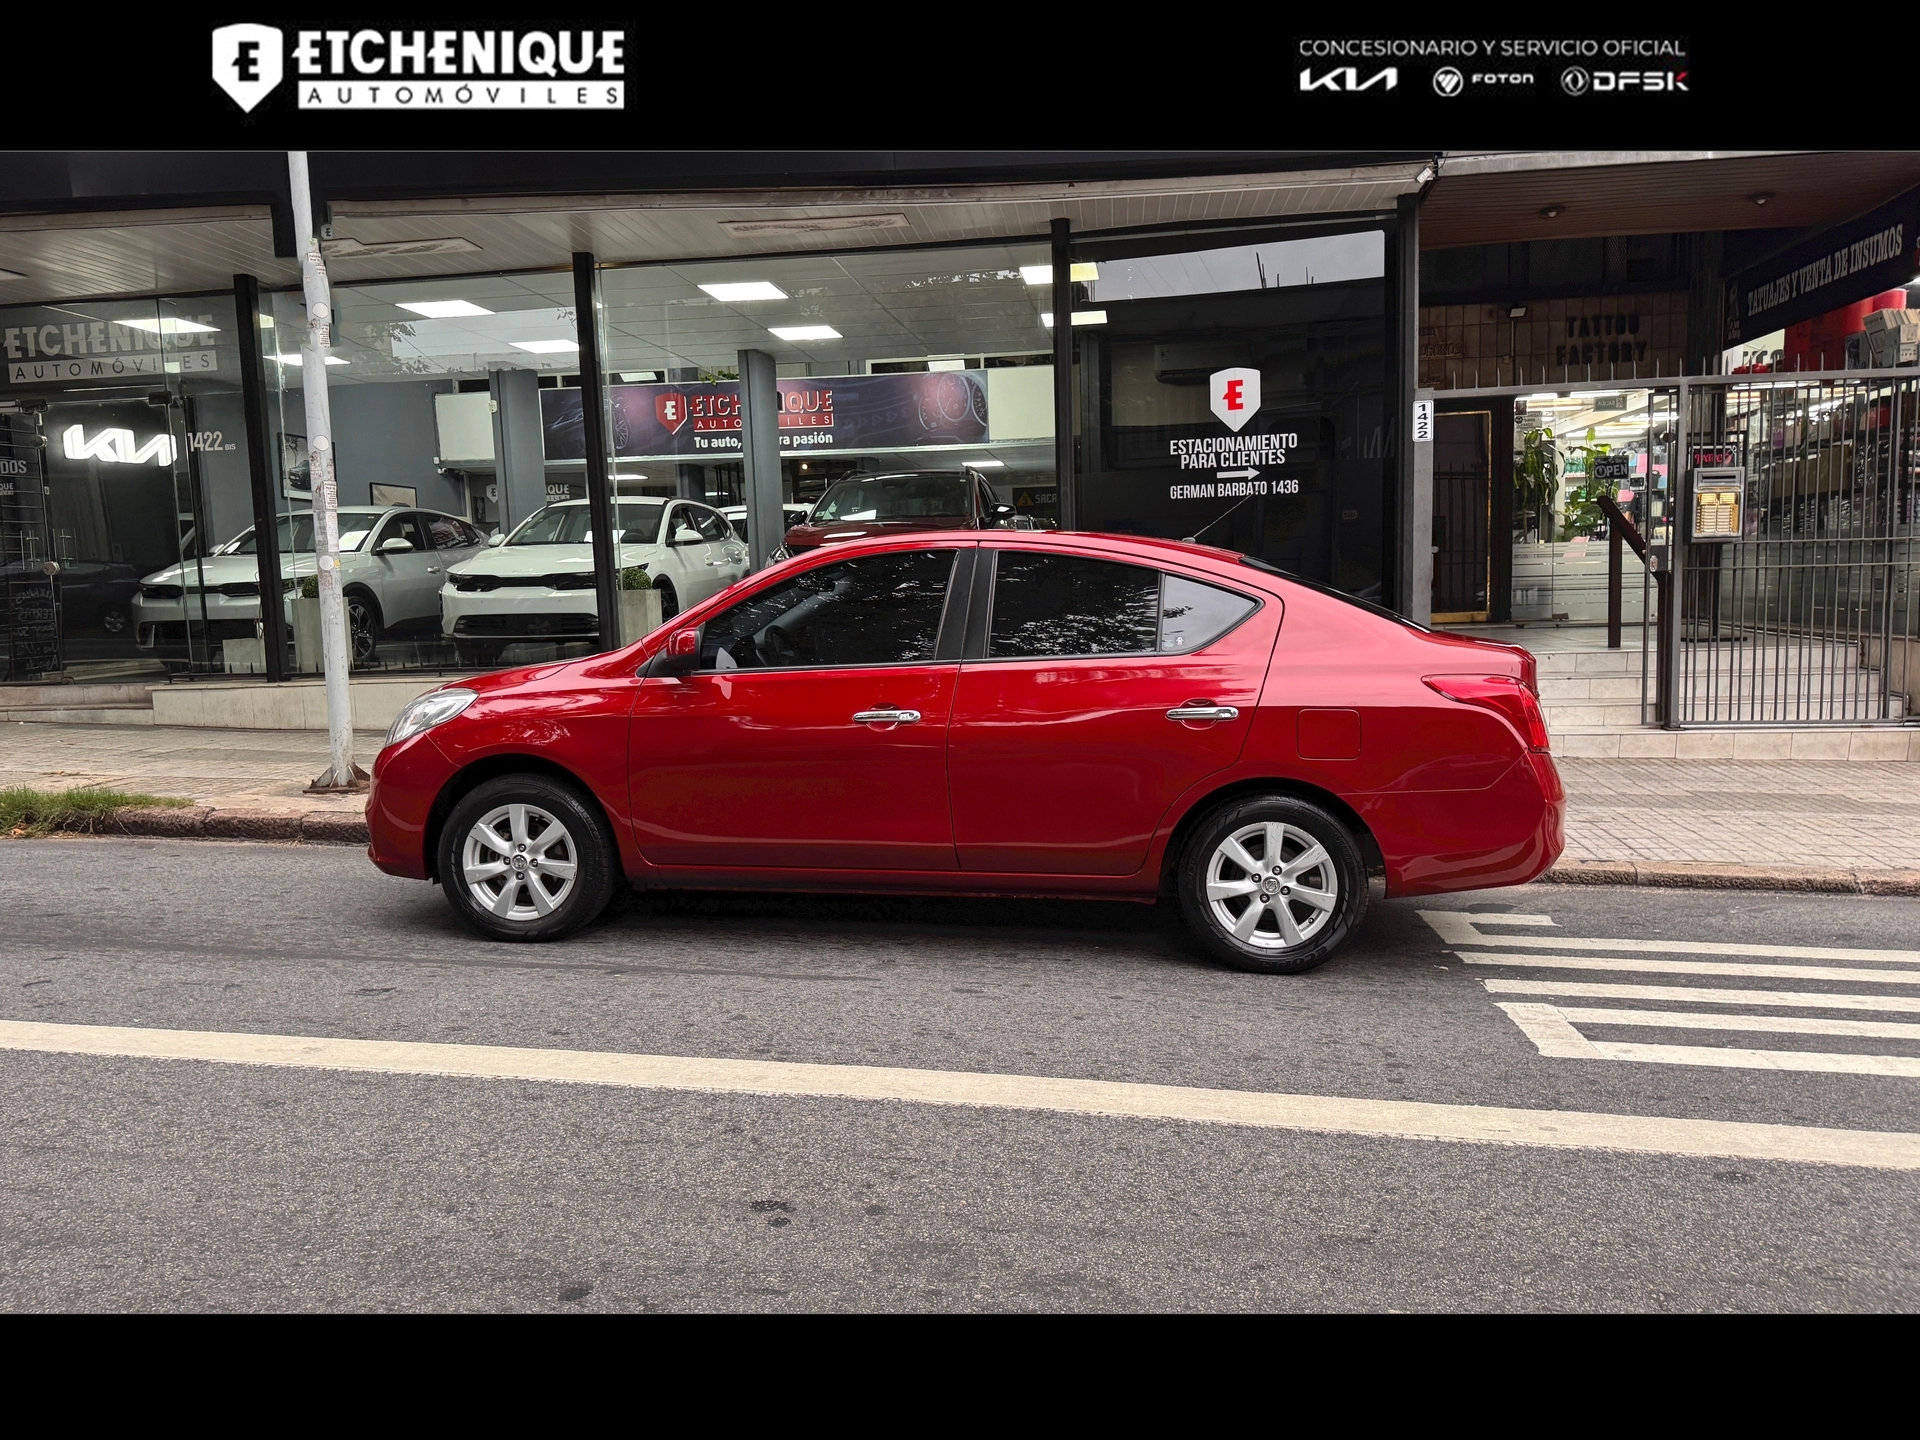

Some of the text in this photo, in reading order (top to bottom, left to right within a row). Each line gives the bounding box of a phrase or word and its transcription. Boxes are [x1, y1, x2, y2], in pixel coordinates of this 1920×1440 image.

[1747, 224, 1903, 317] TATUAJES Y VENTA DE INSUMOS
[1566, 312, 1640, 338] TATTOO
[1556, 340, 1647, 367] FACTORY
[1416, 403, 1429, 440] 1422
[63, 424, 178, 467] KIA
[188, 431, 224, 452] 1422
[694, 437, 708, 448] Tu
[711, 437, 742, 449] auto,
[793, 432, 833, 448] pasión
[1169, 432, 1298, 456] ESTACIONAMIENTO
[1181, 449, 1286, 470] PARA CLIENTES
[1594, 464, 1628, 479] OPEN
[1170, 480, 1299, 500] GERMAN BARBATO 1436
